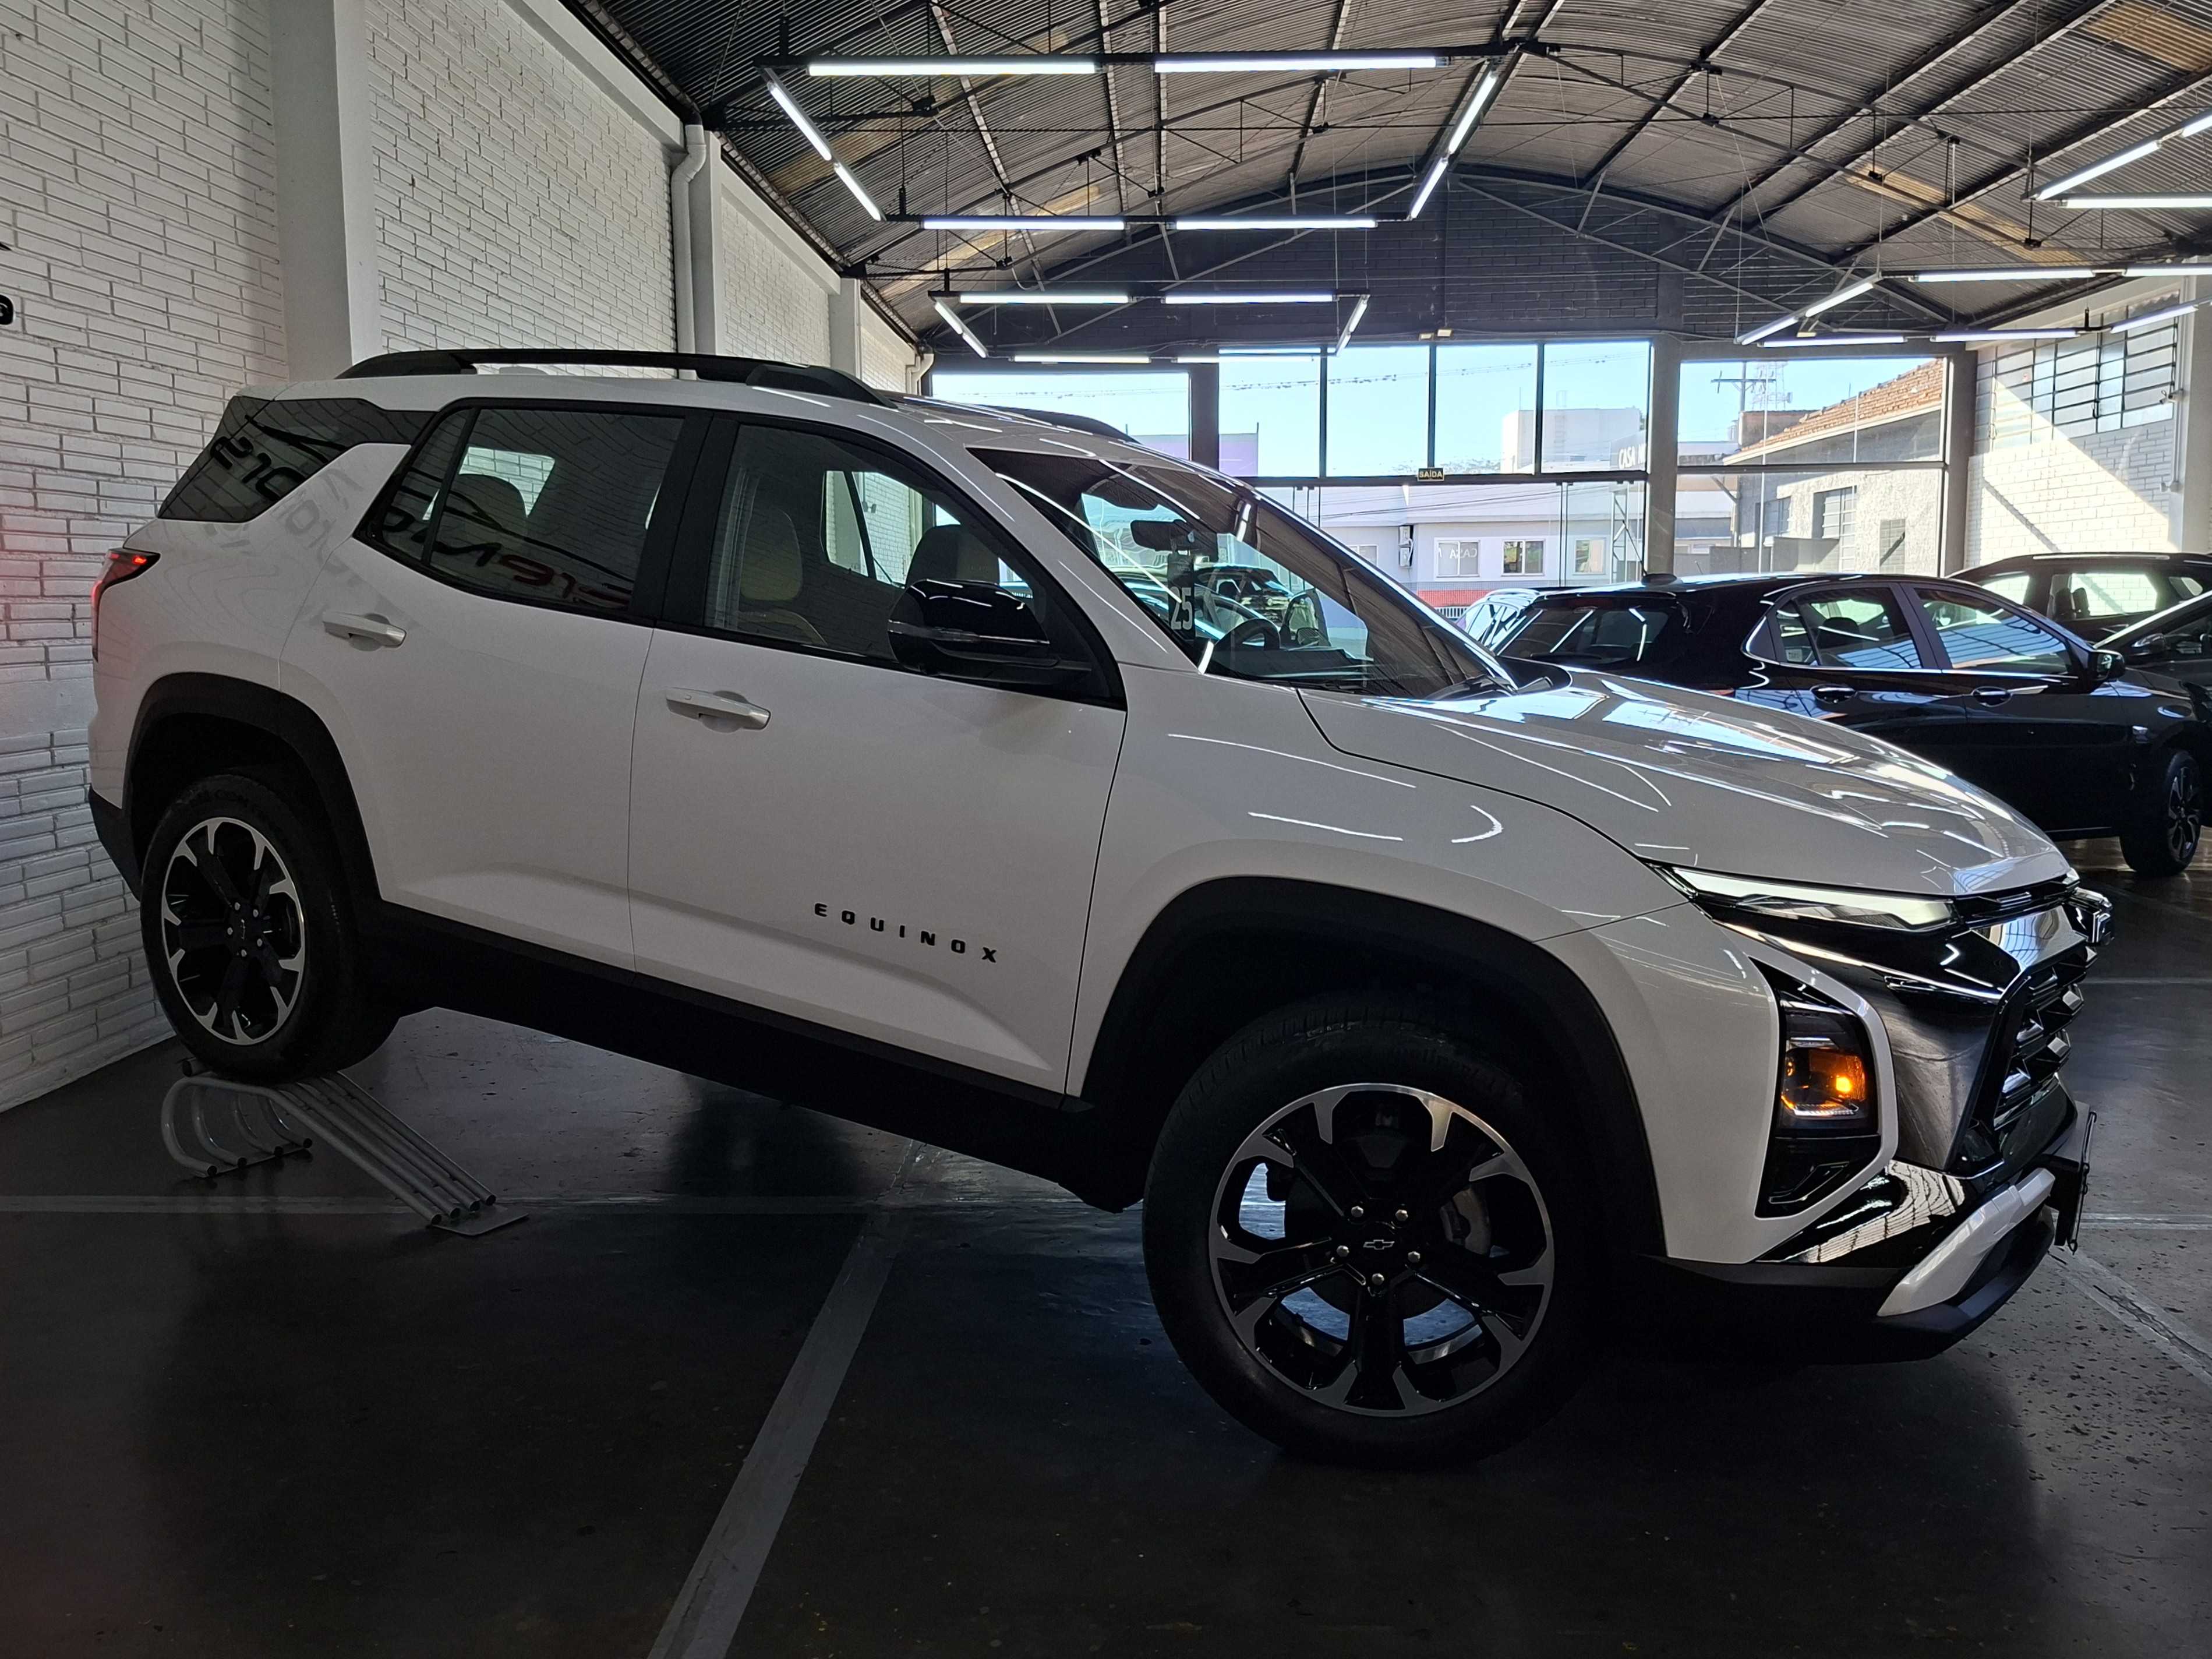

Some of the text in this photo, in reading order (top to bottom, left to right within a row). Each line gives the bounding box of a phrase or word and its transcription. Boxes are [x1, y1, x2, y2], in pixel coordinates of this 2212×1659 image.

[1419, 469, 1443, 478] SAÍDA
[1619, 446, 1636, 469] CASA
[1170, 587, 1193, 630] 25
[814, 902, 997, 963] EQUINOX
